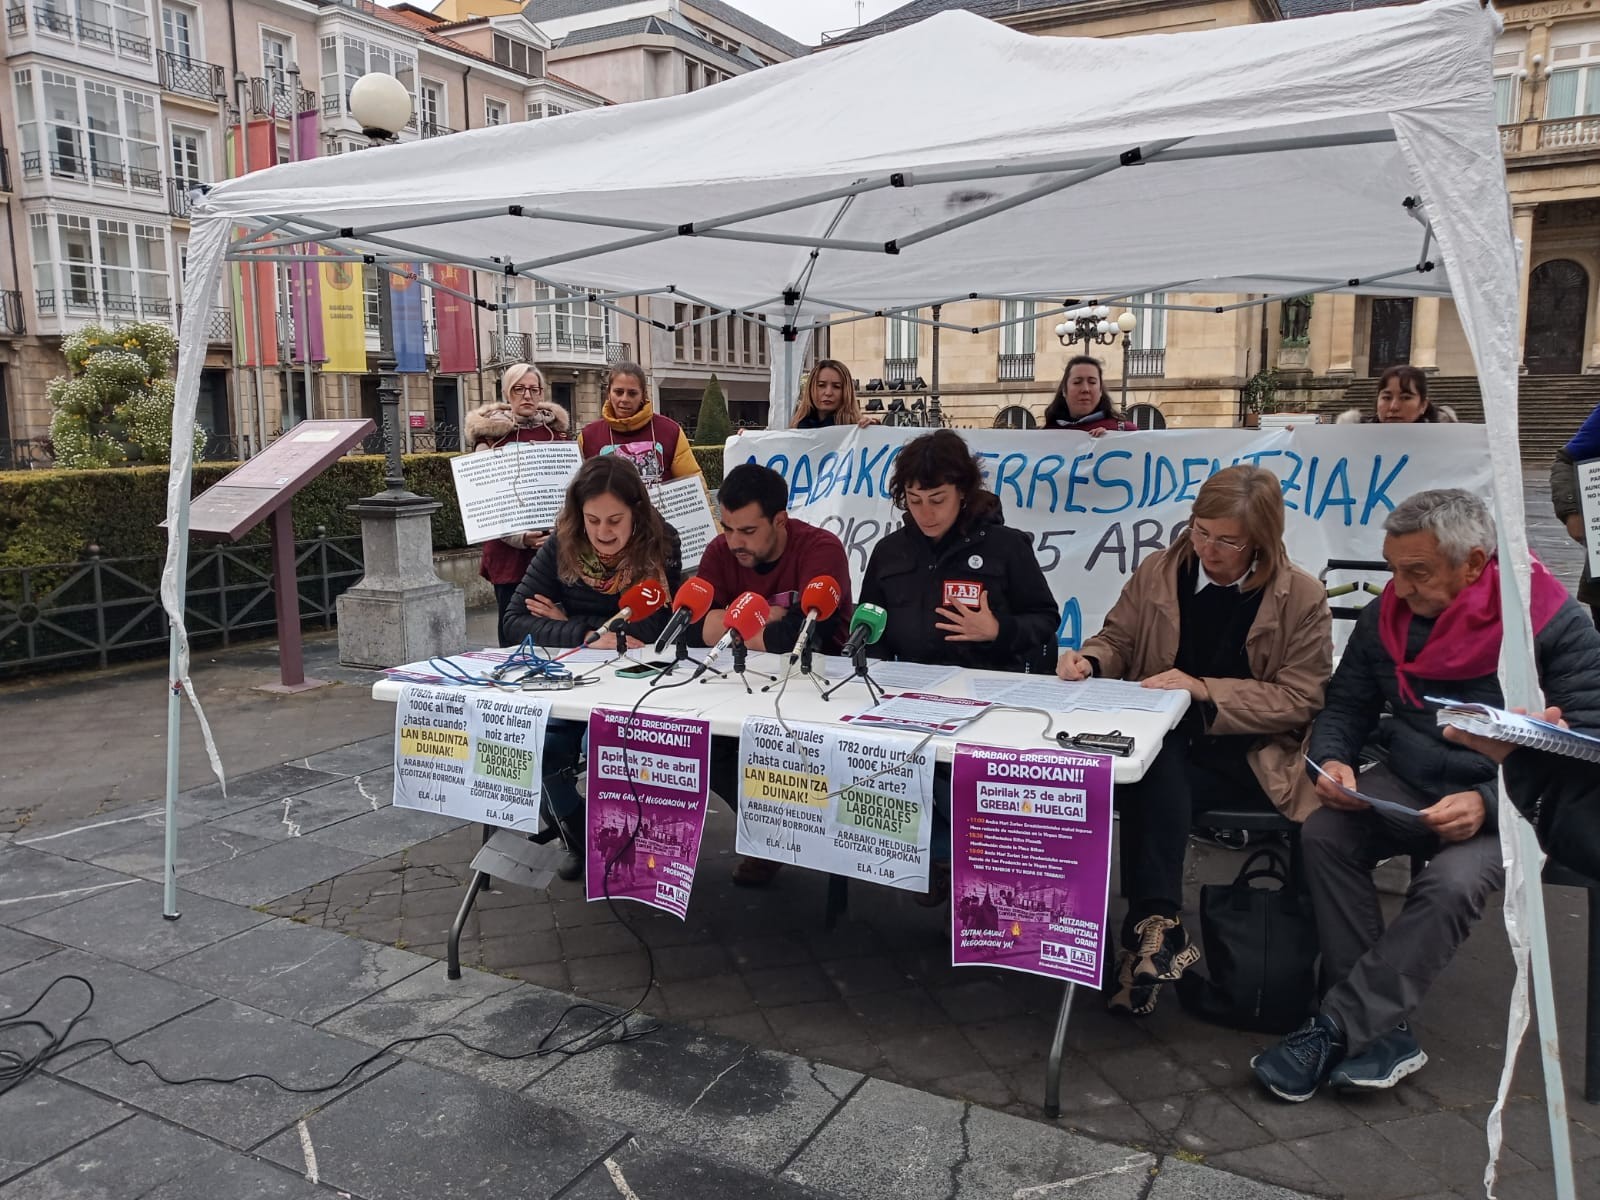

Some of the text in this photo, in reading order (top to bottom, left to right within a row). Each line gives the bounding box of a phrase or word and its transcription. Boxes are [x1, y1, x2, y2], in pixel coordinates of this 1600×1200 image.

[746, 444, 905, 509] ABAKO
[947, 585, 979, 599] LAB
[435, 691, 467, 703] anuales
[410, 699, 464, 715] 1000€ al mes
[476, 699, 543, 718] 1782 ordu urteko
[403, 713, 467, 731] ¿hasta cuando?
[481, 712, 532, 729] 1000€ hilean
[641, 720, 703, 735] ERRESIDENTZIAK
[401, 728, 469, 747] LAN BALDINTZA
[485, 728, 526, 745] noiz arte?
[617, 725, 691, 748] BORROKAN!!
[753, 722, 825, 744] 1782h. anuales
[416, 742, 454, 757] DUINAK!
[477, 742, 533, 762] CONDICIONES
[755, 737, 820, 759] 1000€ al mes
[838, 740, 860, 754] 1782
[862, 745, 887, 759] ordu
[404, 758, 464, 775] ARABAKO HELDUEN
[481, 753, 528, 771] LABORALES
[601, 751, 696, 774] Apirak 25 de abril
[748, 752, 826, 776] ¿hasta cuando?
[847, 756, 878, 772] 1000€
[972, 750, 1100, 768] ARABAKO ERRESIDENTZIAK
[400, 768, 465, 786] EGOITZAK BORROKAN
[486, 765, 521, 780] DIGNAS!
[601, 765, 697, 789] GREBA! HUELGA!
[745, 767, 828, 793] LAN BALDINTZA
[987, 762, 1085, 783] BORROKAN!!
[473, 780, 532, 798] ARABAKO HELDUEN
[762, 785, 809, 804] DUINAK!
[878, 780, 907, 795] arte?
[980, 785, 1082, 804] Apirilak 25 de abril
[470, 787, 534, 807] EGOITZAK BORROKAN
[840, 790, 919, 814] CONDICIONES
[486, 809, 497, 819] ELA
[502, 812, 514, 822] LAB
[748, 800, 823, 823] ARABAKO HELDUEN
[846, 802, 911, 824] LABORALES
[980, 799, 1083, 818] GREBA! HUELGA!
[744, 811, 826, 836] EGOITZAK BORROKAN
[854, 814, 902, 834] DIGNAS!
[766, 838, 780, 848] ELA
[787, 842, 802, 853] LAB
[834, 838, 921, 864] EGOITZAK BORROKAN
[837, 830, 918, 854] ARABAKO HELDUEN
[857, 863, 872, 873] ELA
[880, 868, 895, 879] LAB
[658, 884, 675, 898] ELA
[1049, 924, 1098, 940] PROBINTZIALA
[1059, 917, 1099, 930] HITZARMEN
[1042, 945, 1068, 959] ELA
[1072, 950, 1093, 963] LAB
